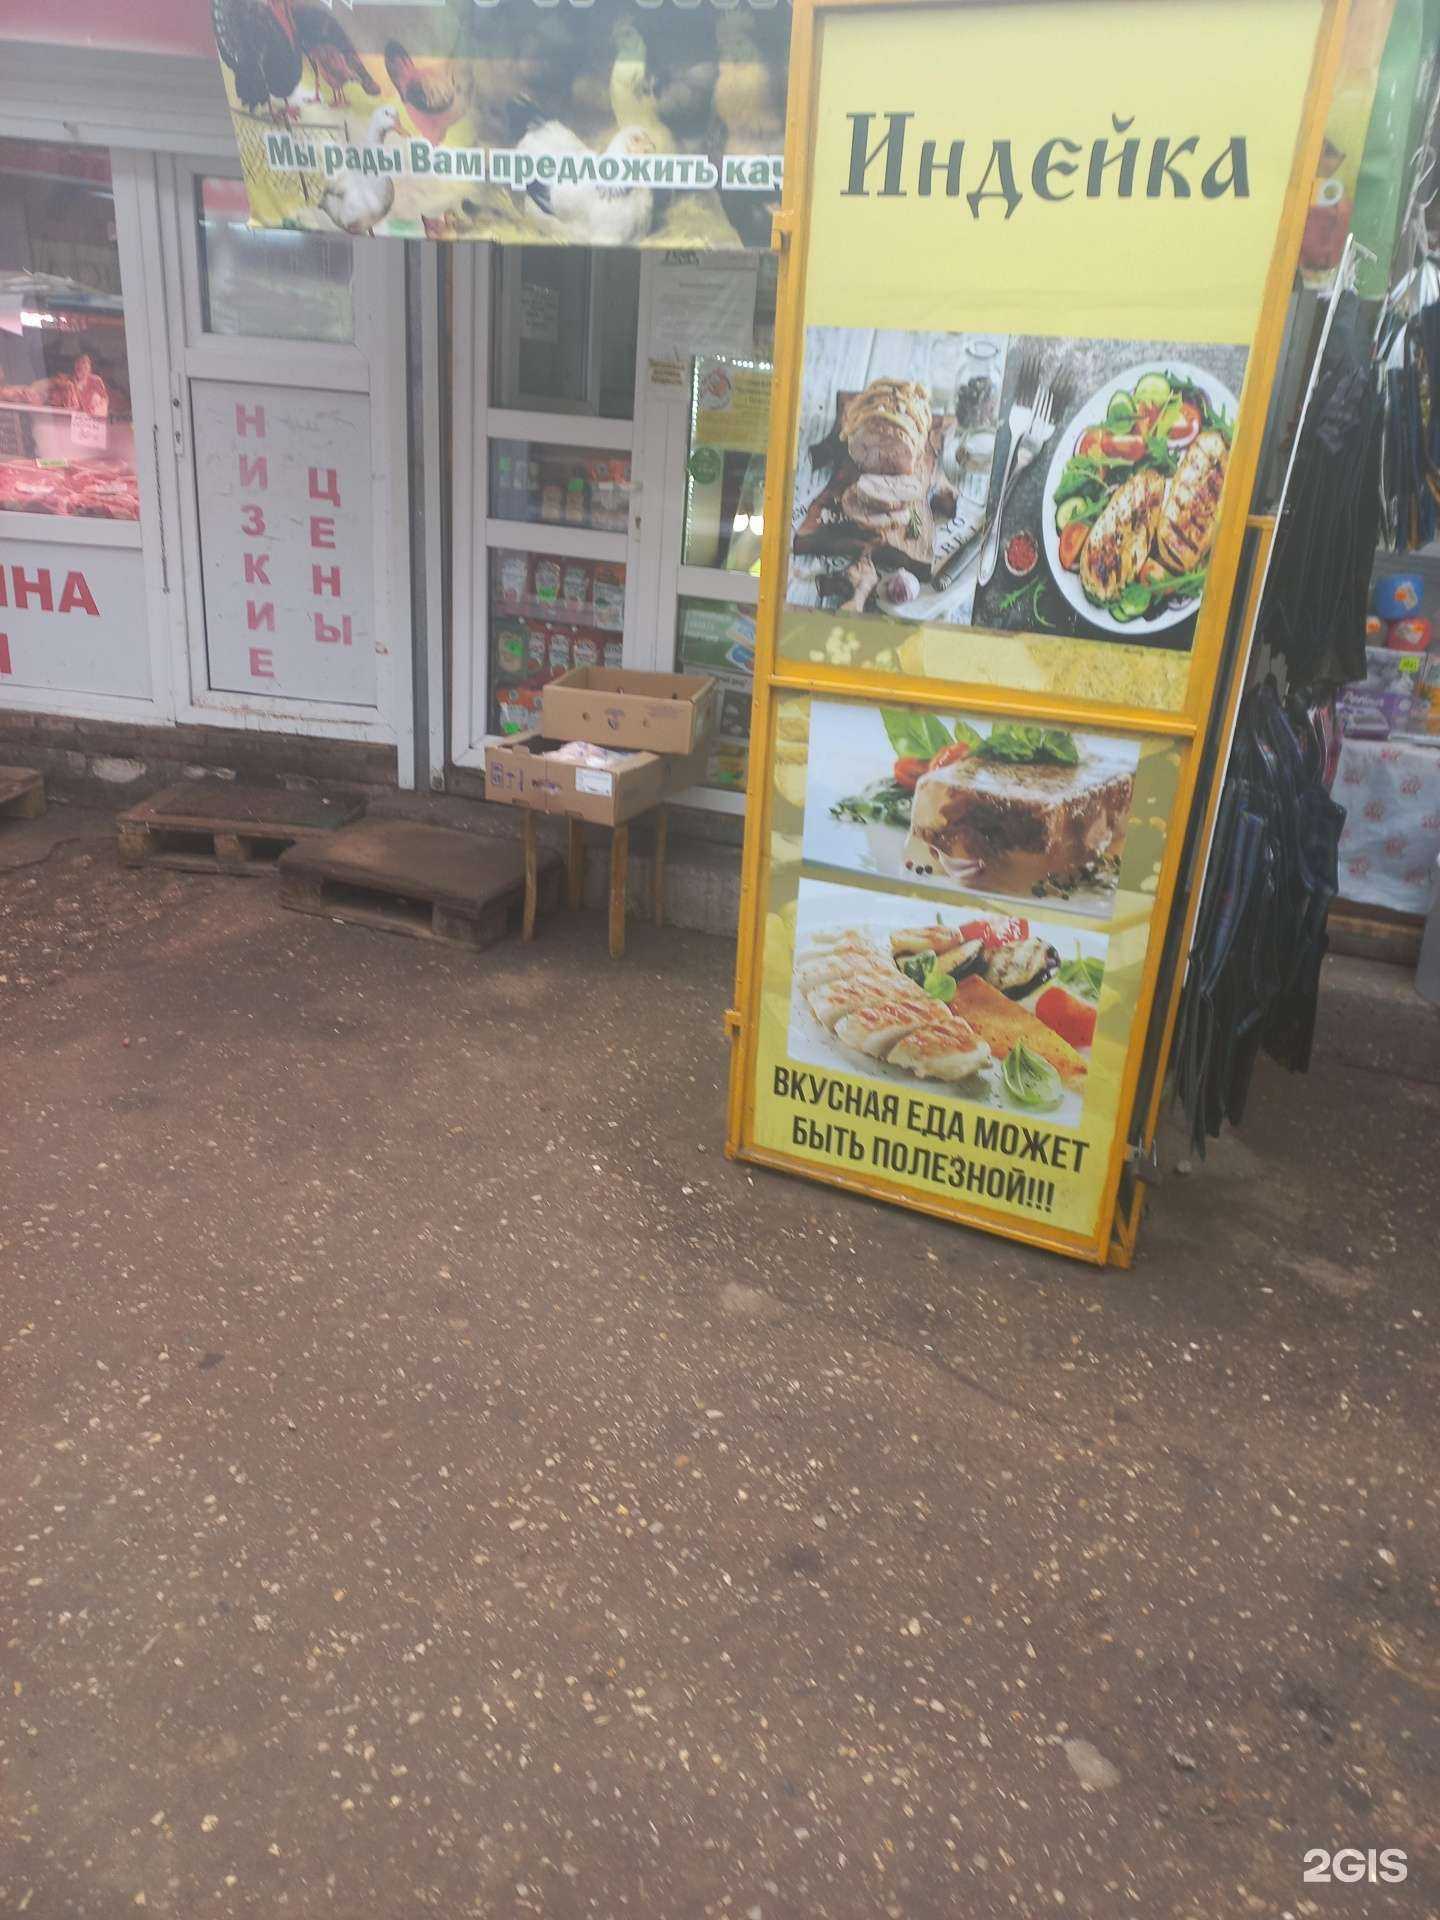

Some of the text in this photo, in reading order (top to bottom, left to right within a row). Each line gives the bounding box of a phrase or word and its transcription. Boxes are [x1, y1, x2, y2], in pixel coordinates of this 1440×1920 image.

[267, 134, 317, 168] Мы
[323, 144, 402, 175] рады
[410, 141, 482, 177] Вам
[492, 152, 715, 185] предложить
[840, 111, 1250, 220] Индейка
[235, 403, 276, 678] НИЗКИЕ
[308, 467, 353, 646] ЦЕНЫ
[773, 1065, 1090, 1173] ВКУСНАЯ ЕДА МОЖЕТ
[792, 1115, 1056, 1213] БЫТЬ ПОЛЕЗНОЙ!!!
